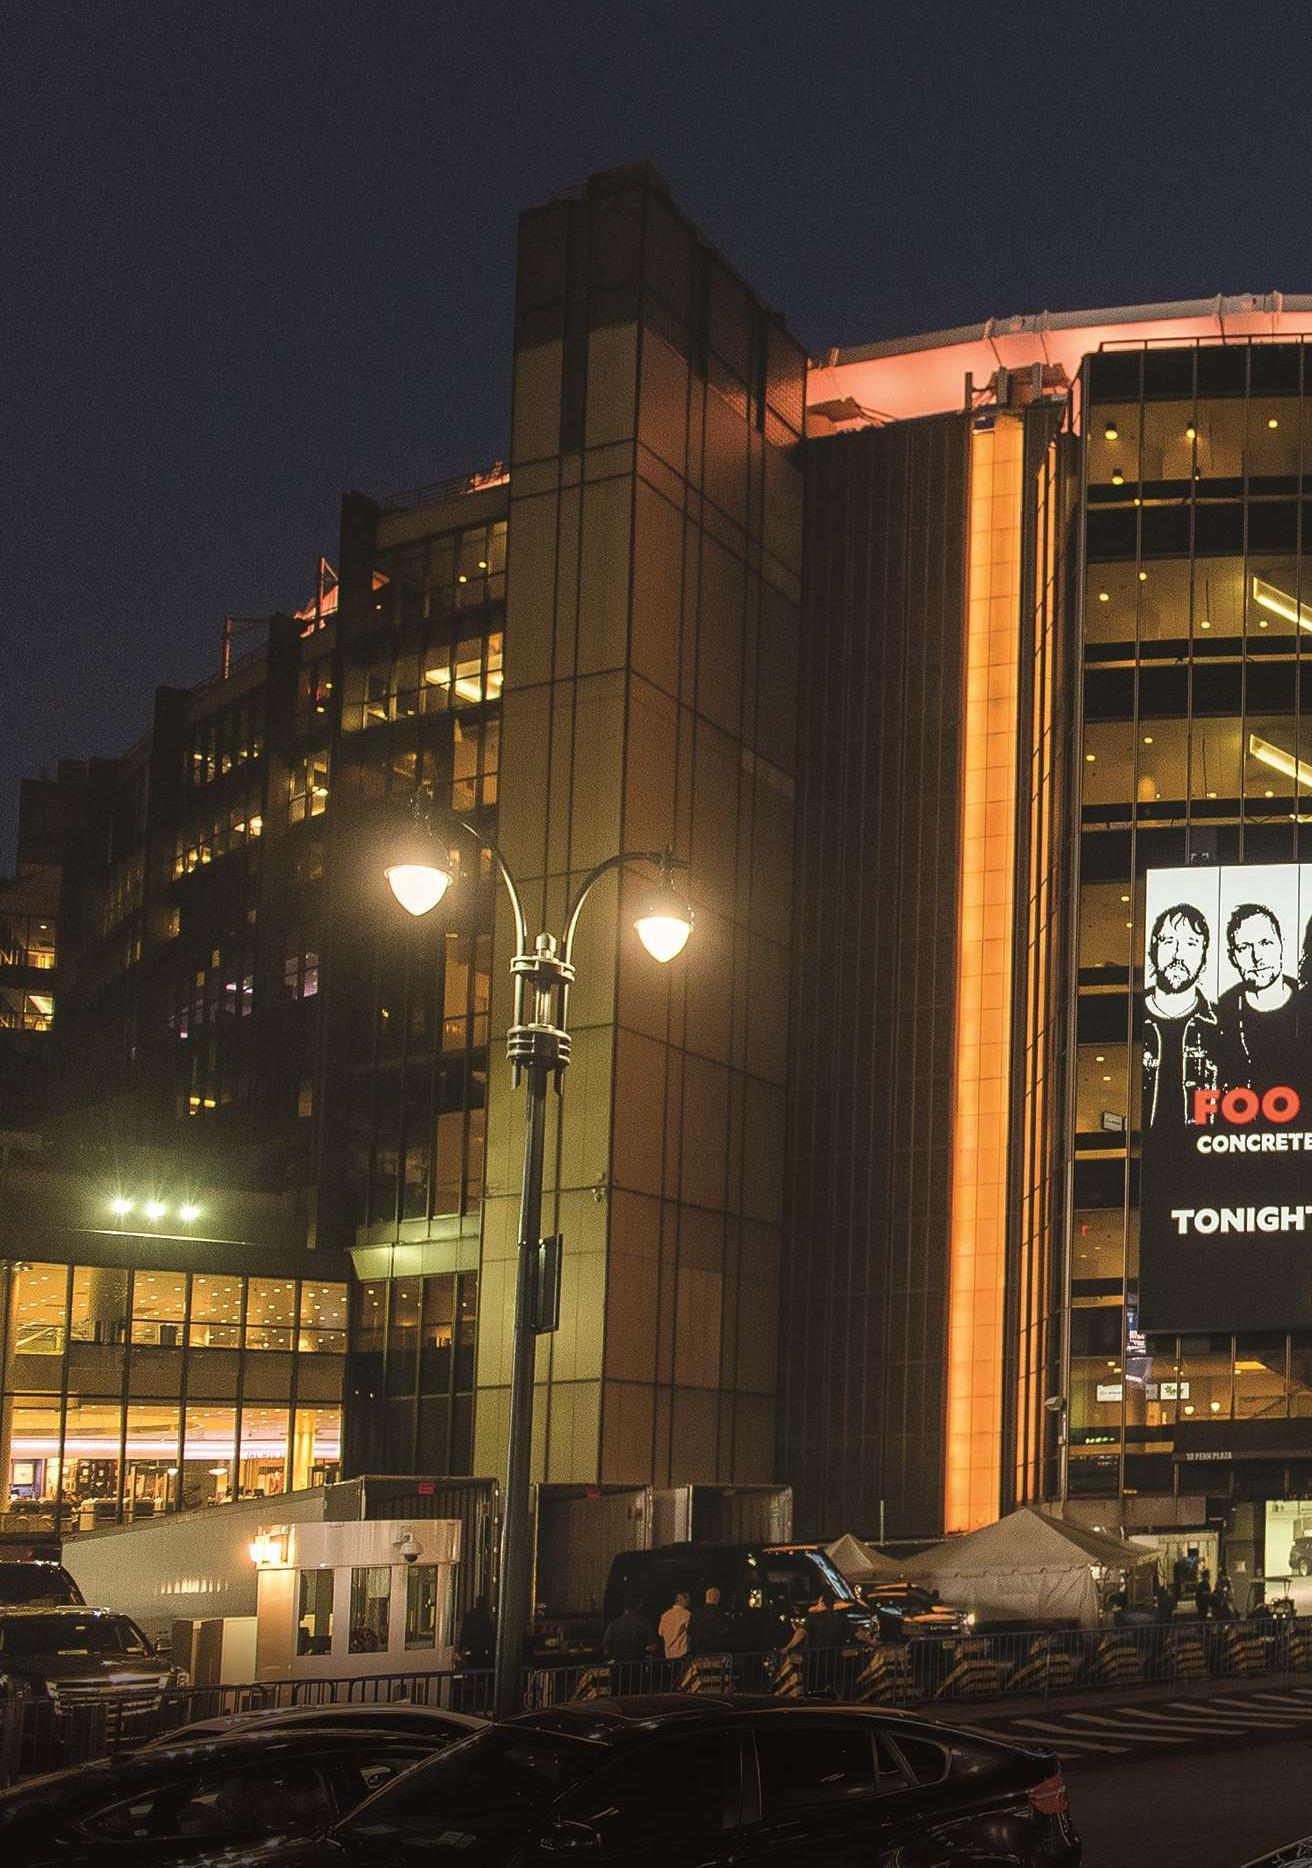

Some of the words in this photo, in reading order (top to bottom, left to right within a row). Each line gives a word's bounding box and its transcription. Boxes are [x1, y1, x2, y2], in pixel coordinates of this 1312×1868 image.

[1193, 1086, 1300, 1126] FOO
[1195, 1452, 1212, 1460] PENN
[1212, 1451, 1233, 1460] PLAZA
